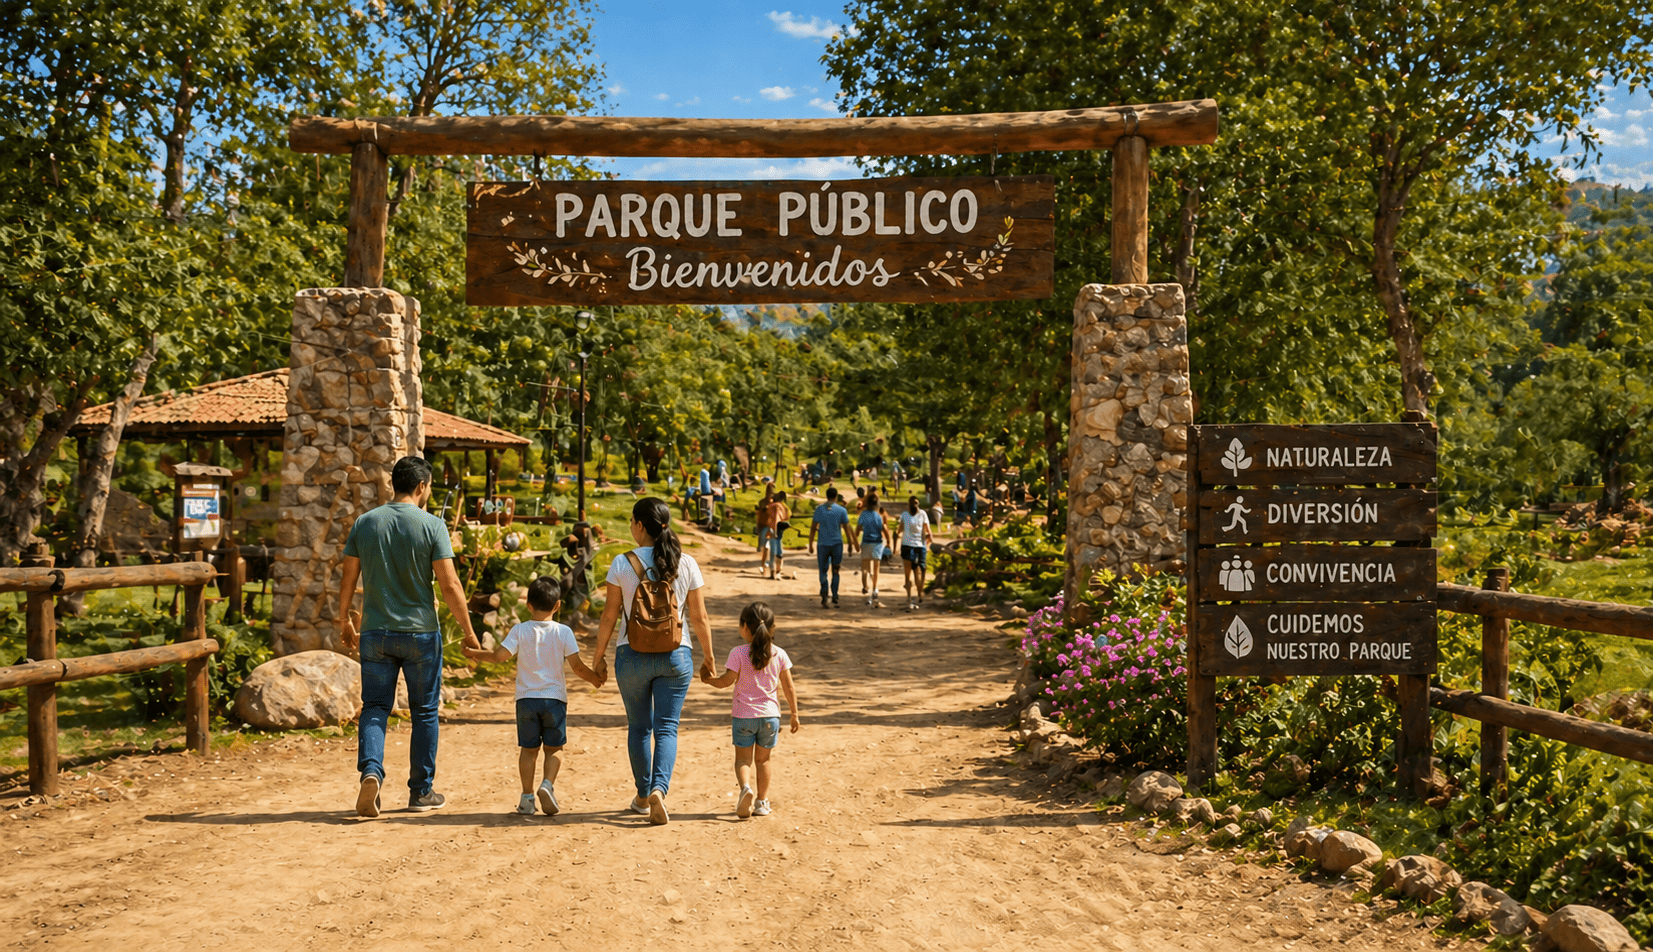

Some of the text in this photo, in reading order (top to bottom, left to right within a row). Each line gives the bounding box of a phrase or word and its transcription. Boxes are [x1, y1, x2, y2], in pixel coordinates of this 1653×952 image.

[555, 181, 978, 240] PARQUE PÚBLICO
[625, 246, 901, 291] Bienvenidos
[1266, 446, 1393, 467] NATURALEZA
[1267, 497, 1378, 524] DIVERSIÓN
[1266, 563, 1396, 583] CONVIVENCIA
[1267, 614, 1364, 634] CUIDEMOS
[1267, 642, 1412, 660] NUESTRO PARQUE
